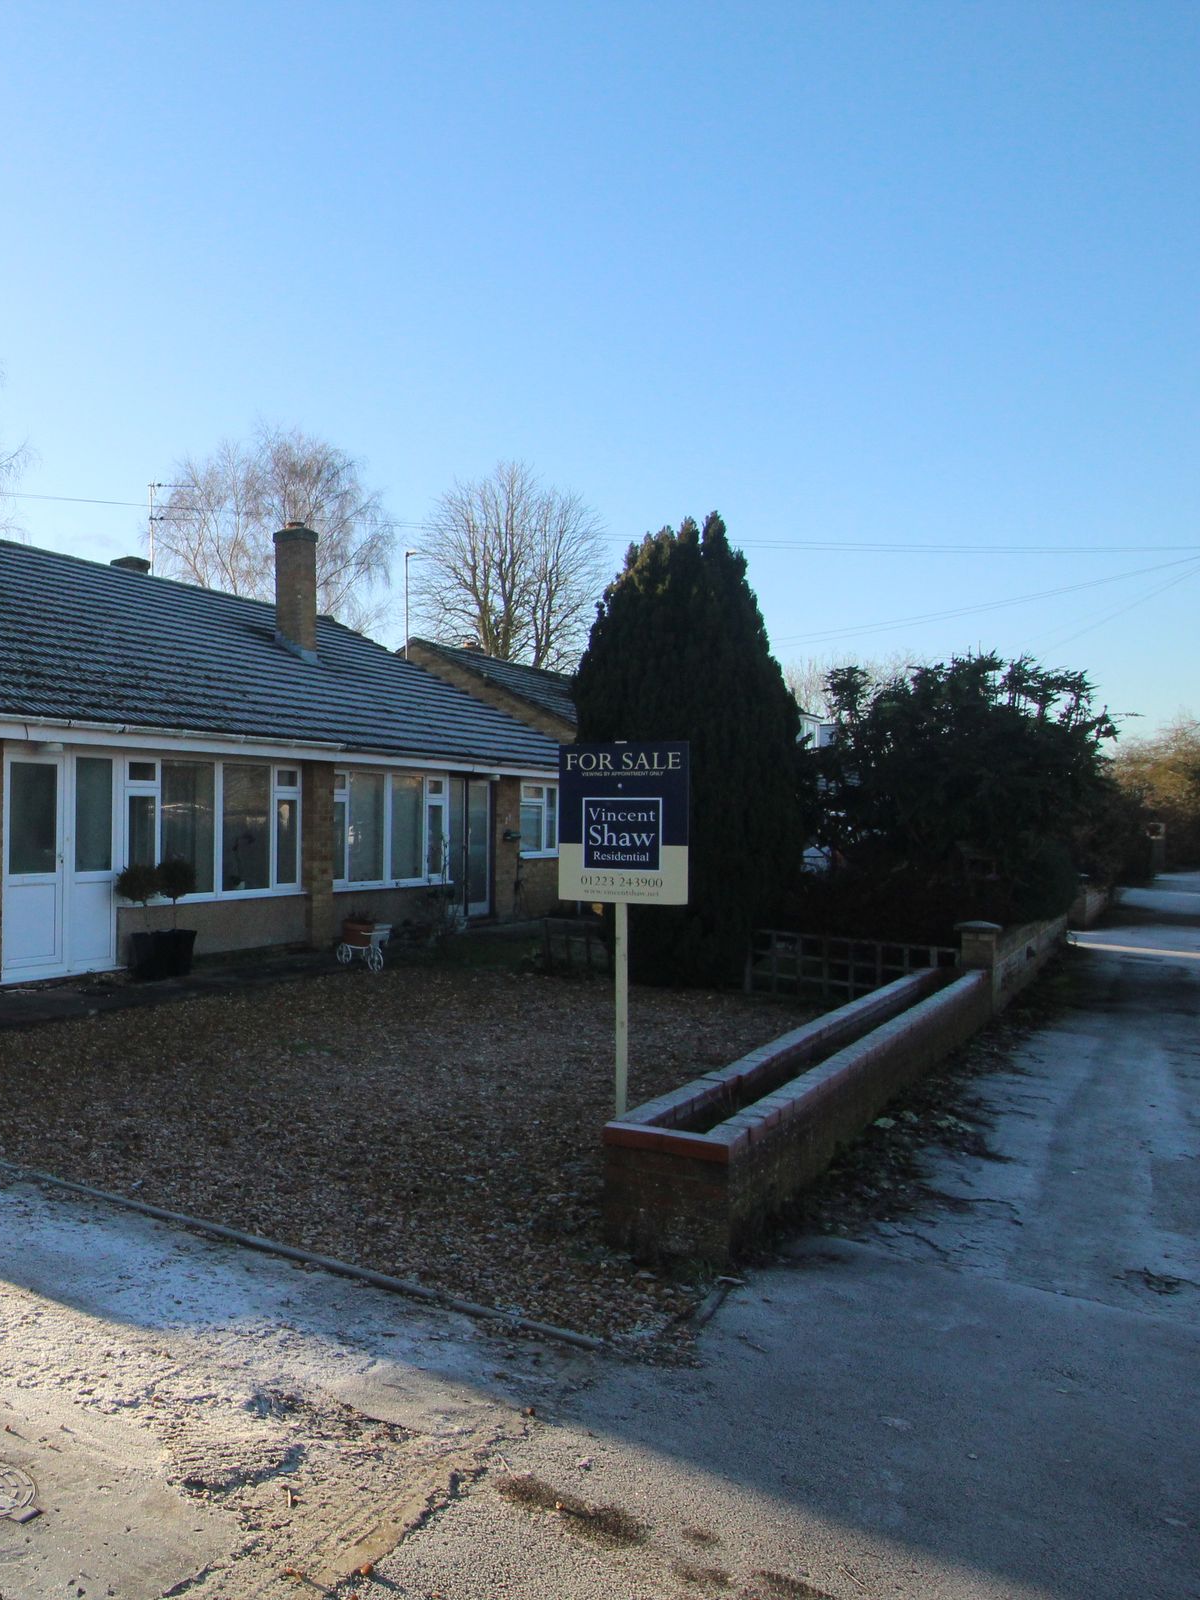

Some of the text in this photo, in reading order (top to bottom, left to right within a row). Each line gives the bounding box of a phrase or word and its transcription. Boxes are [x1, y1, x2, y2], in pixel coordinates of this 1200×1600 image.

[566, 752, 681, 771] FOR SALE
[589, 807, 656, 822] Vincent
[589, 824, 655, 847] Shaw
[593, 850, 649, 862] Residential
[580, 875, 663, 888] 01223 243900
